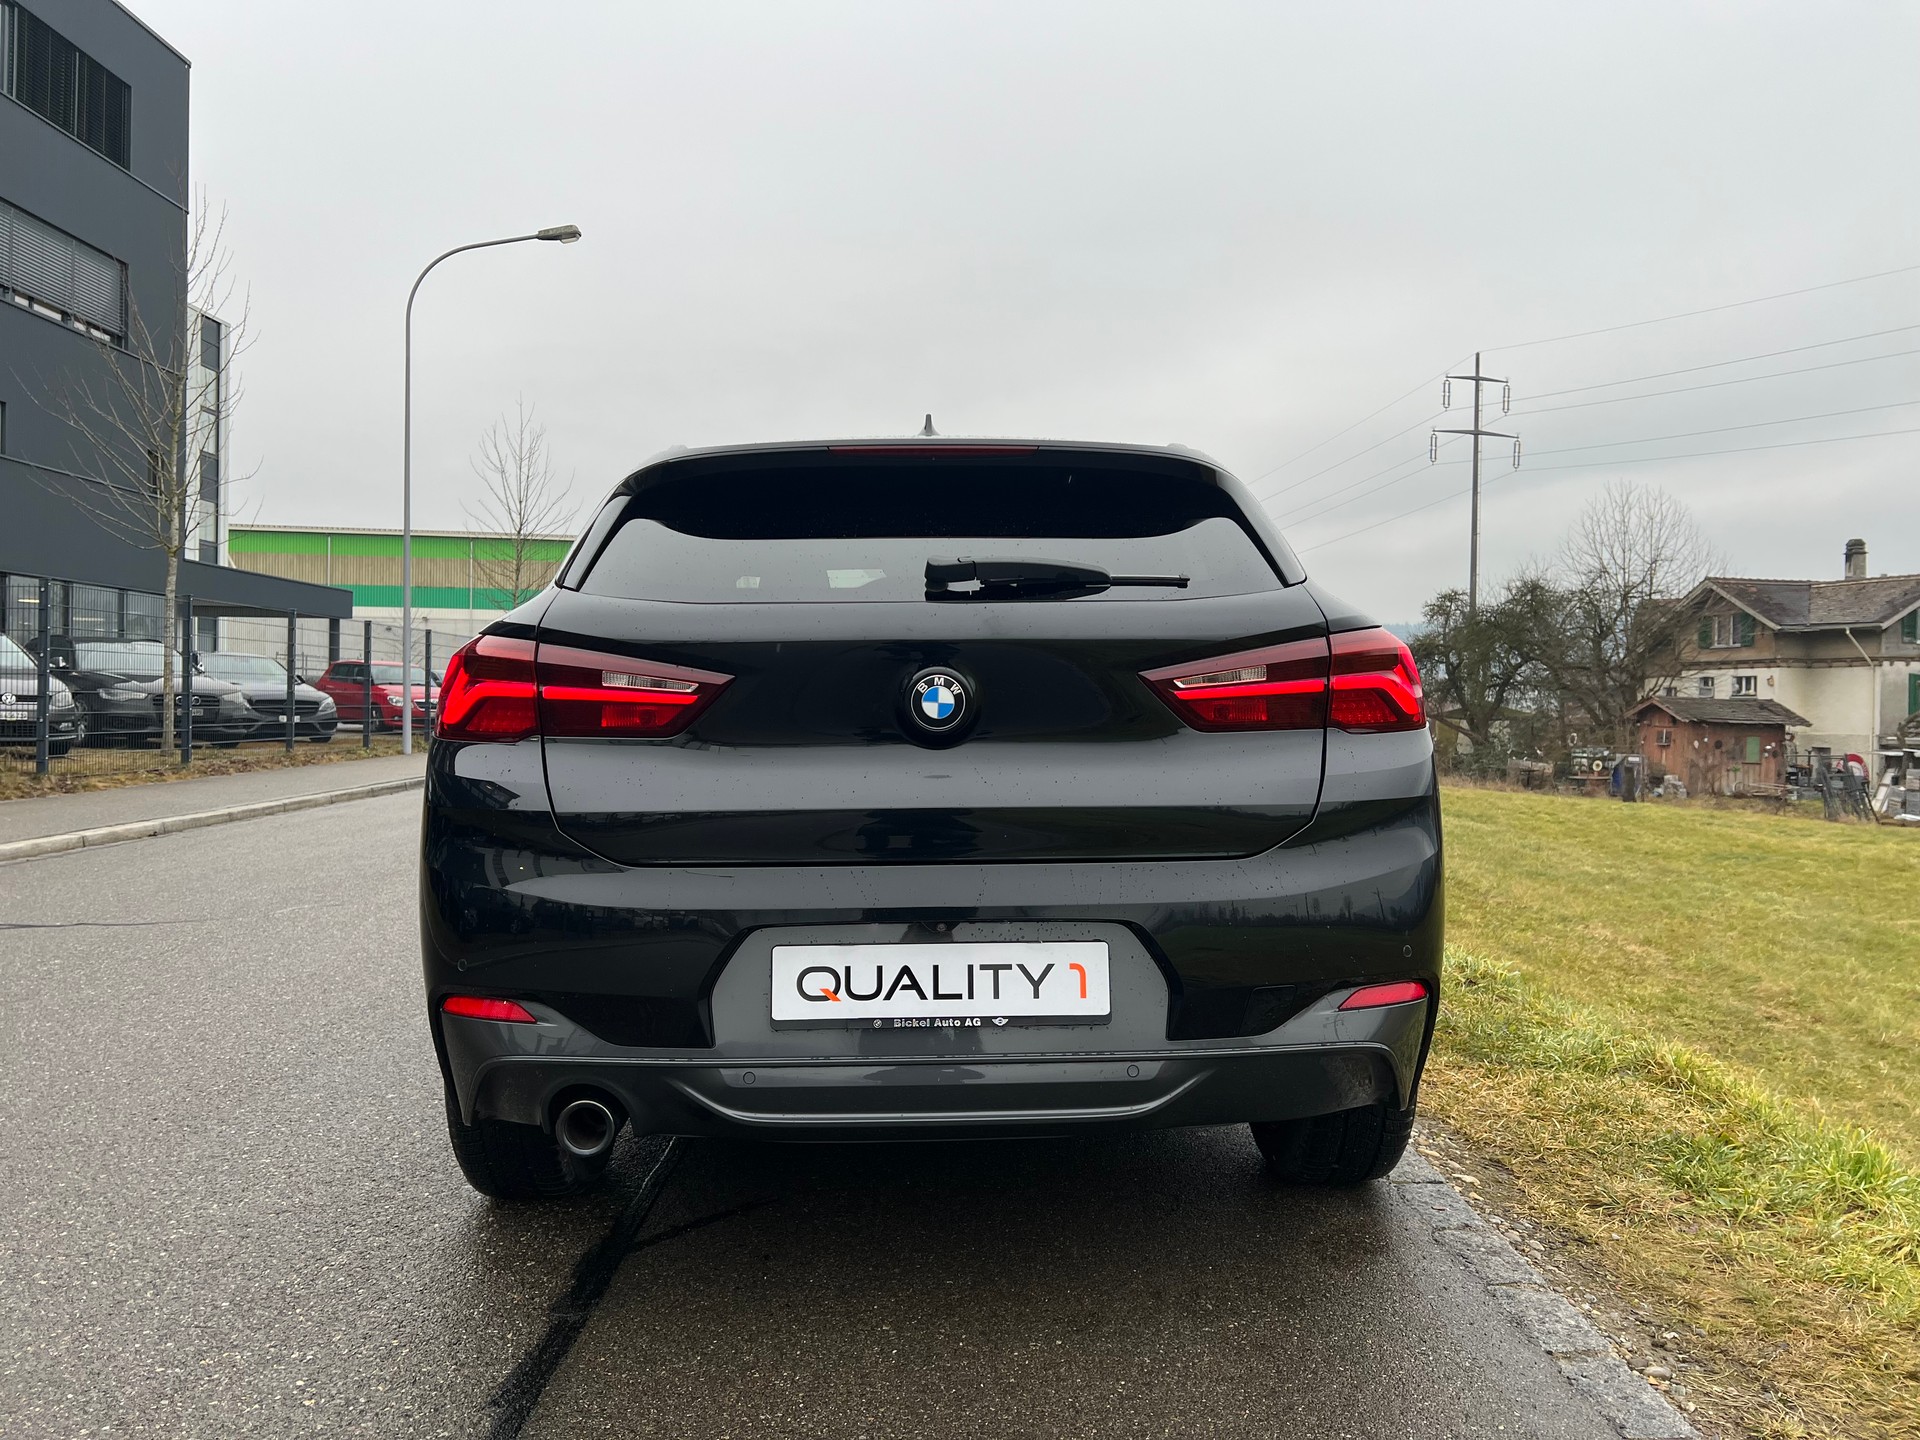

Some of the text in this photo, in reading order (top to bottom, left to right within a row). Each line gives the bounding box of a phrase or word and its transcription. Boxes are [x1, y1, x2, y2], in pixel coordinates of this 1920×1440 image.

[917, 677, 962, 695] BMW
[796, 962, 1087, 1002] QUALITY 1
[893, 1017, 982, 1028] Bickel Auto AG
